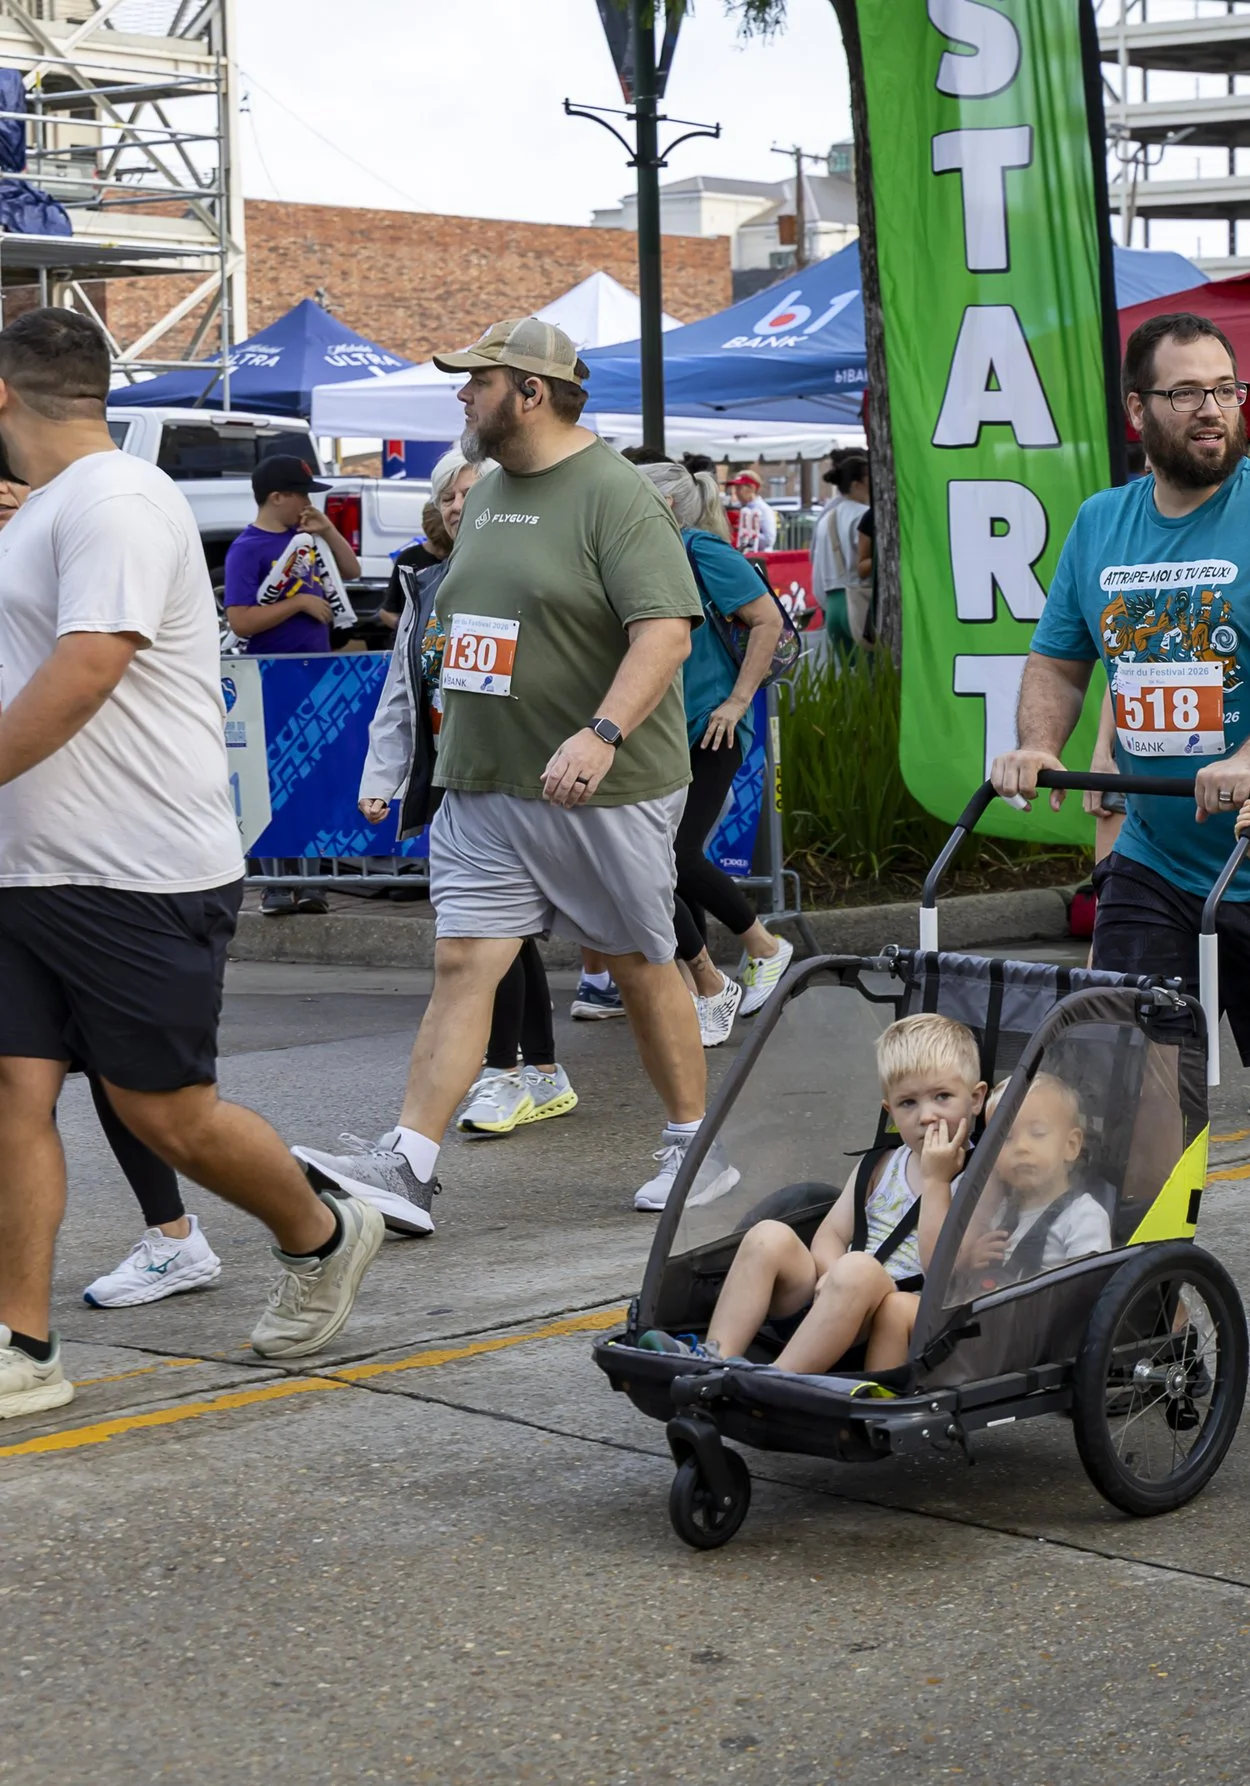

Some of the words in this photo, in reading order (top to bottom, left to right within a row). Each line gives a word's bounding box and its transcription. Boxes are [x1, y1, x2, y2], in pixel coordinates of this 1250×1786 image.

[753, 289, 860, 335] b1
[721, 335, 808, 349] BANK
[324, 353, 402, 367] ULTRA
[834, 368, 868, 384] b1BA
[928, 0, 1061, 787] START
[492, 513, 540, 525] FLYGUYS
[1184, 568, 1199, 580] TU
[1199, 566, 1231, 581] PEUX!
[492, 622, 509, 631] 2026
[449, 635, 498, 672] 130
[1136, 668, 1147, 677] du
[1150, 667, 1185, 676] Festival
[1188, 667, 1209, 676] 2026
[1124, 688, 1200, 730] 518
[1223, 711, 1240, 724] 26
